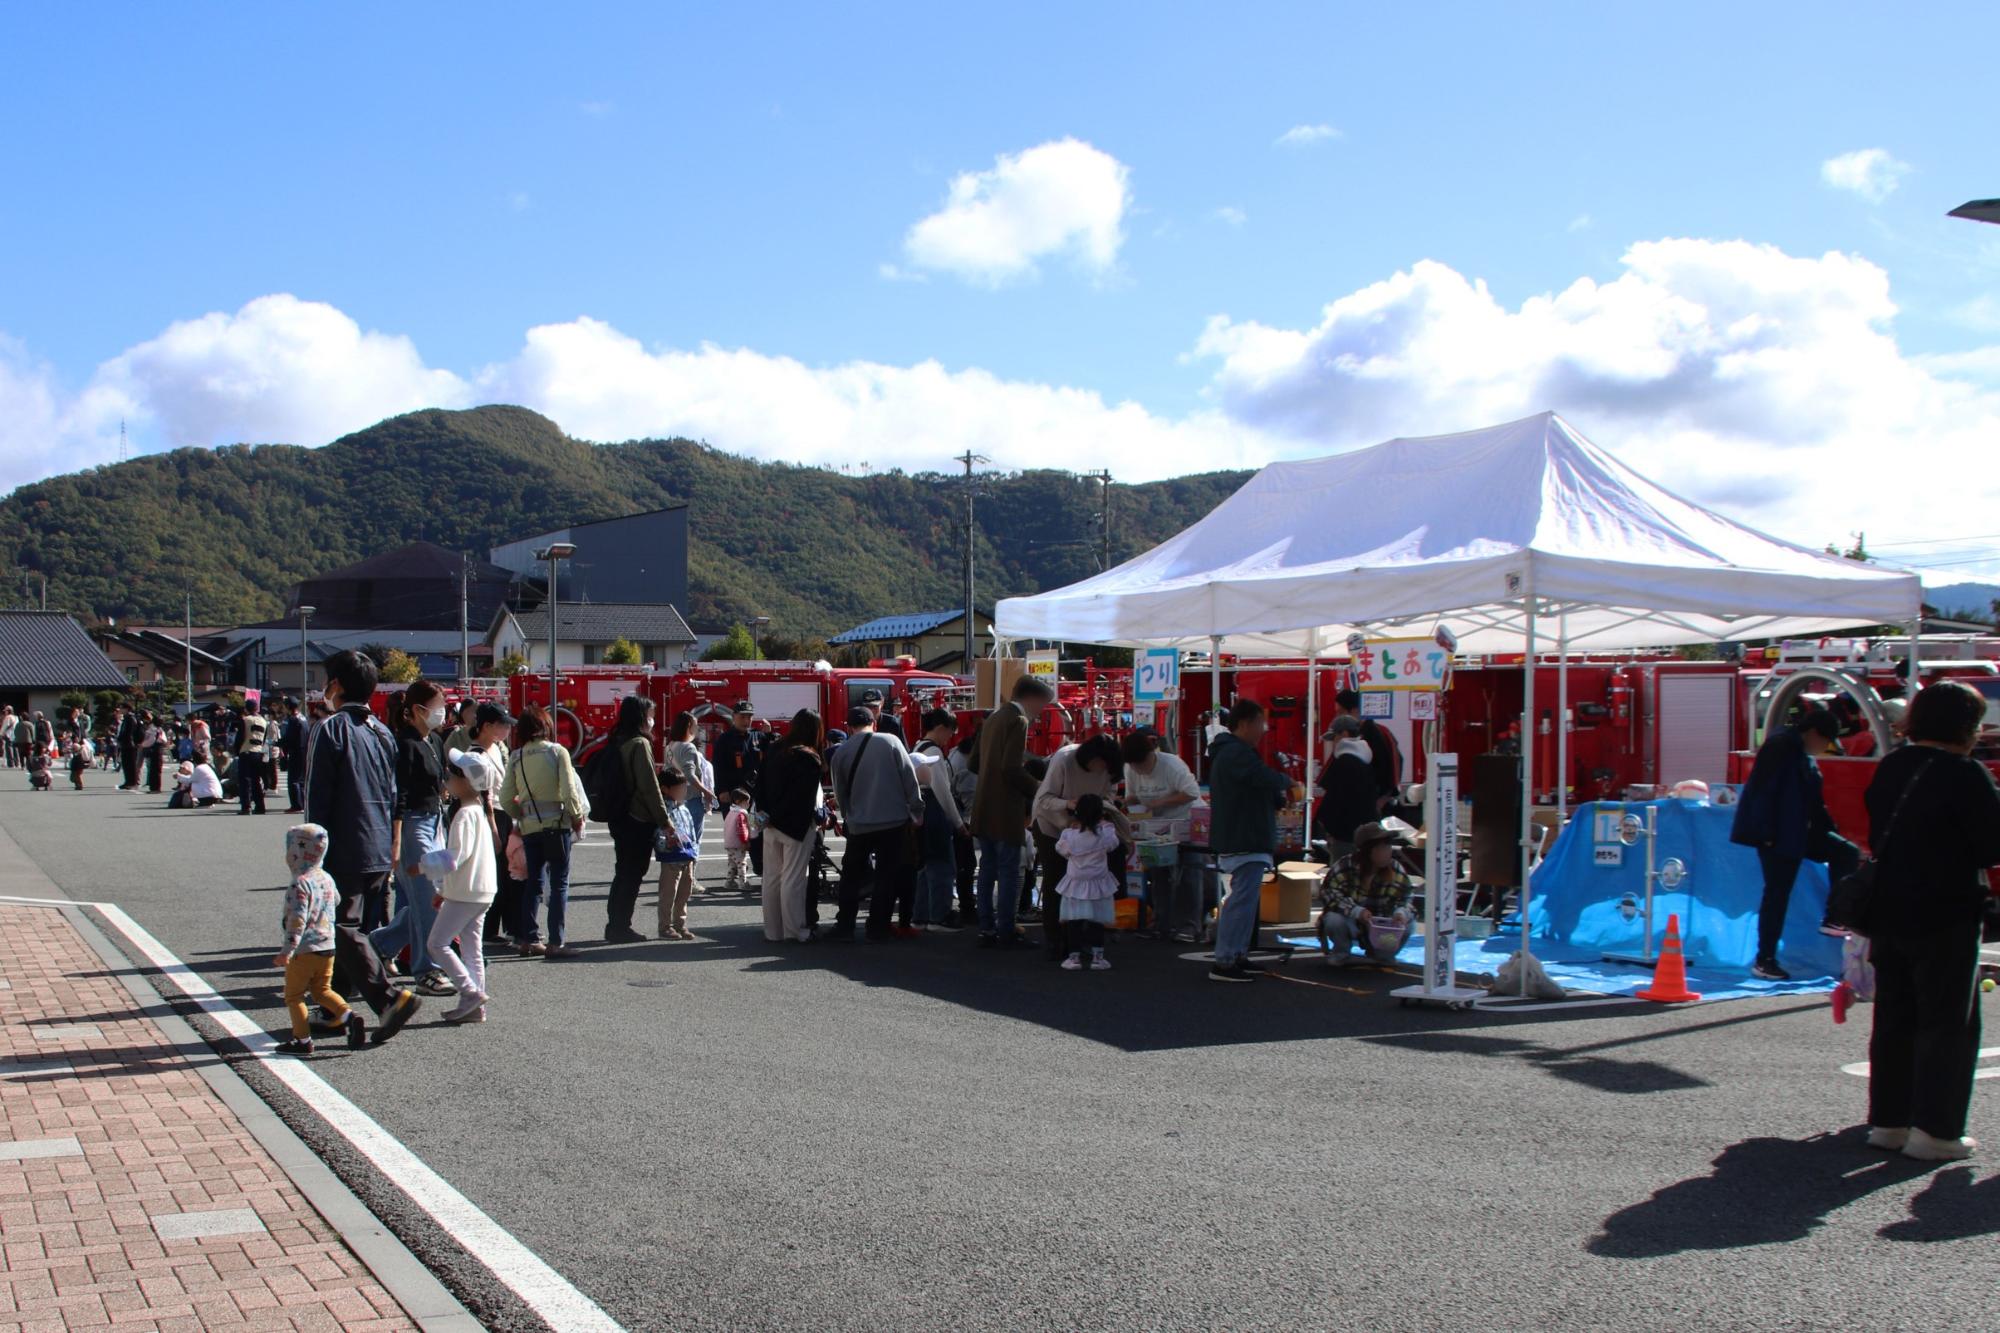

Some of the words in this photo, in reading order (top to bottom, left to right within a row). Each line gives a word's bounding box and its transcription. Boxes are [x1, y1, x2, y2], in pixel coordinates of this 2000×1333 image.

[1141, 662, 1170, 684] つり
[1357, 646, 1444, 683] まとあて
